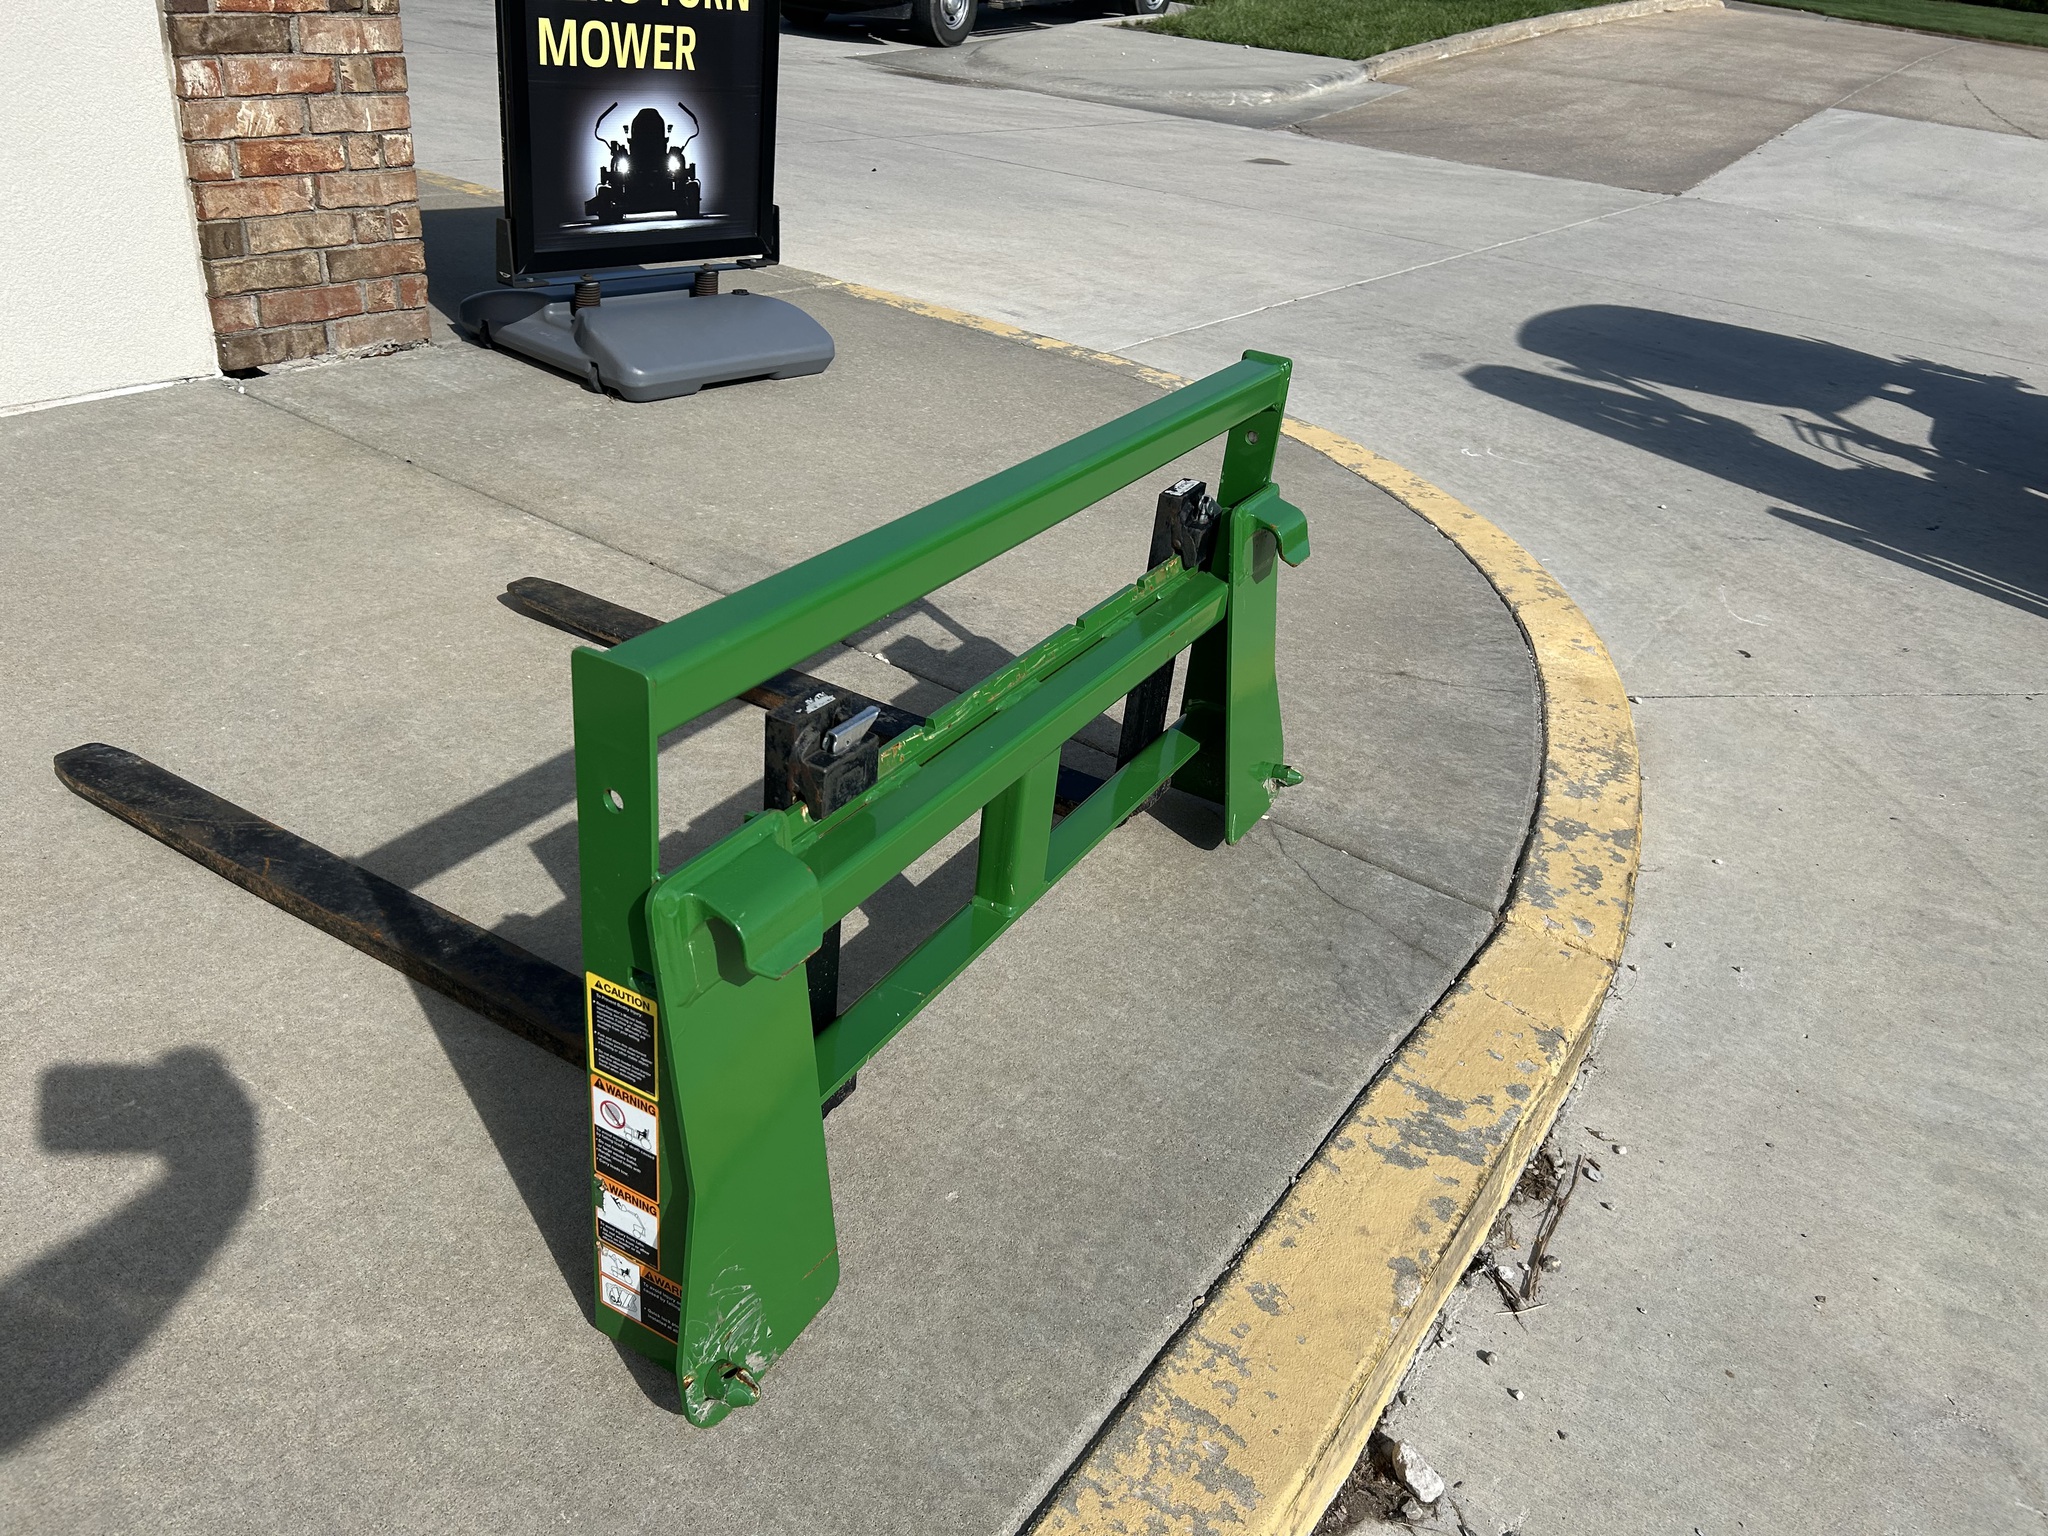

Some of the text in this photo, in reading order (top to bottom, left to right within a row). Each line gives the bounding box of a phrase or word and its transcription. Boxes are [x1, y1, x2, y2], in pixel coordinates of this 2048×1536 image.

[538, 17, 697, 71] MOWER
[603, 984, 650, 1011] CAUTION
[605, 1080, 656, 1117] WARNING
[609, 1183, 657, 1217] WARNING
[656, 1275, 681, 1296] WAR
